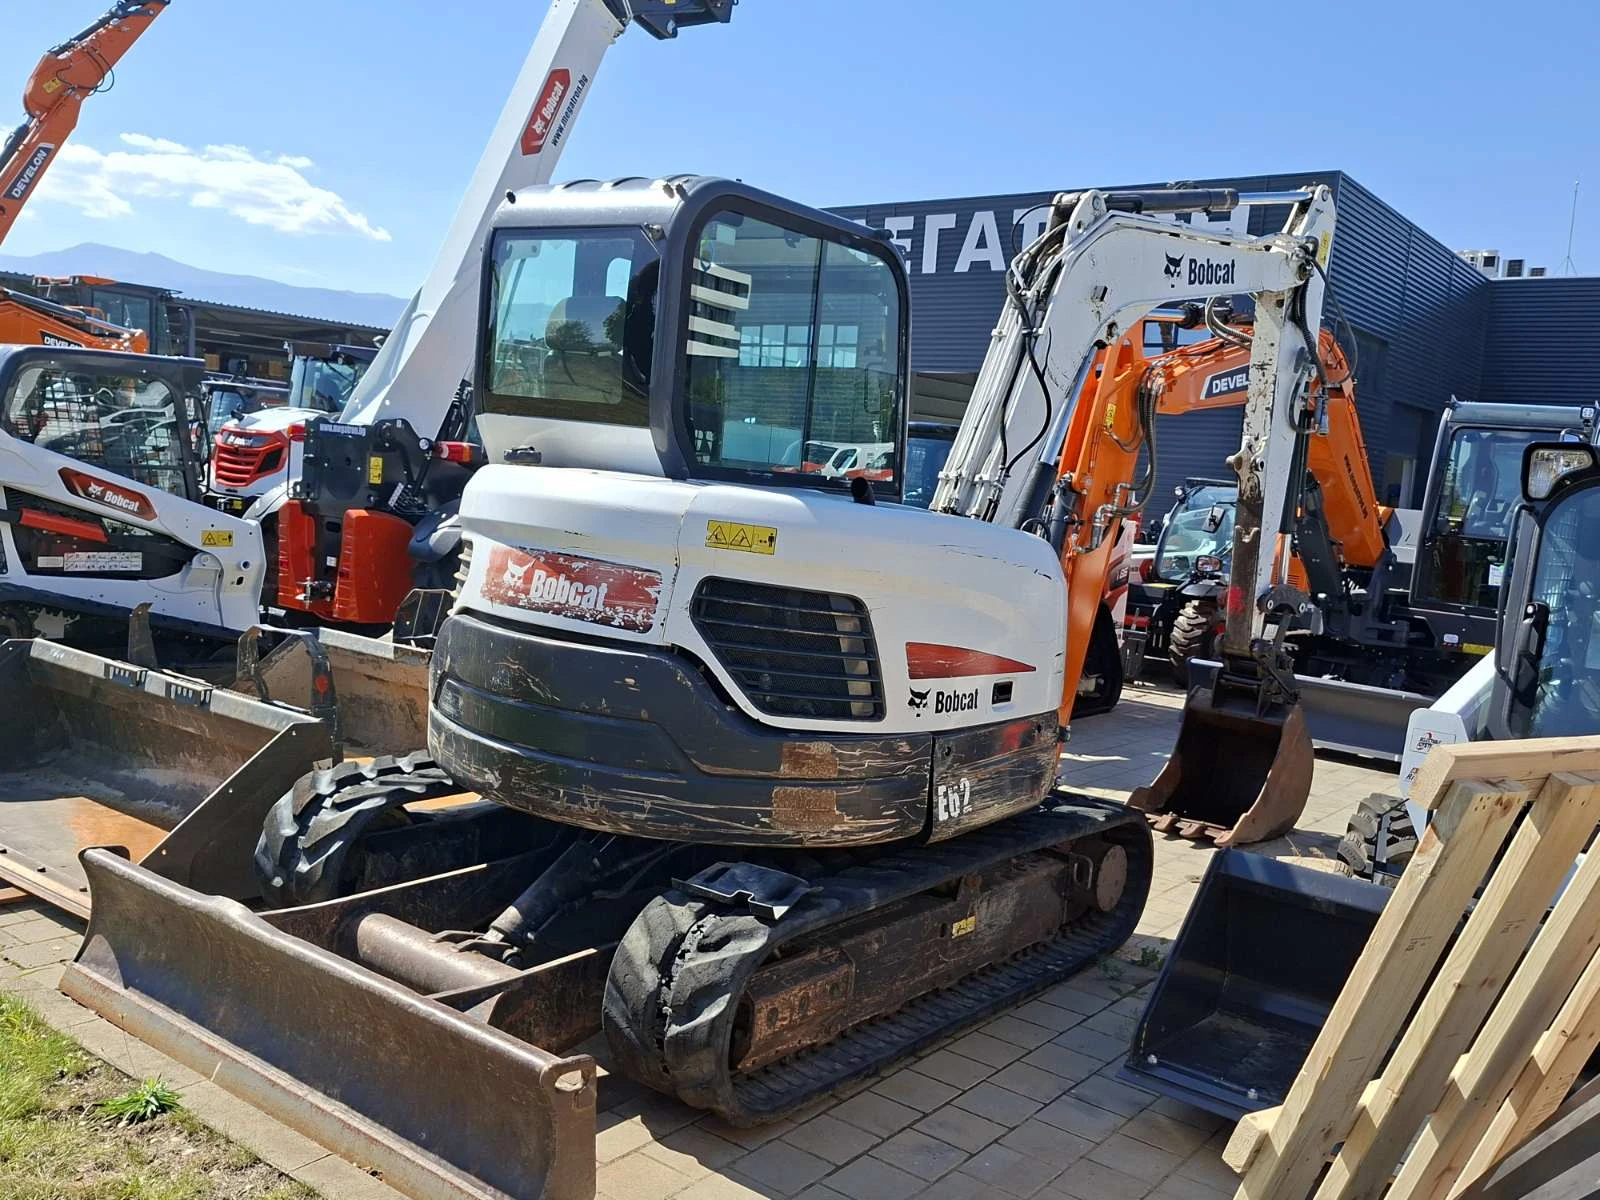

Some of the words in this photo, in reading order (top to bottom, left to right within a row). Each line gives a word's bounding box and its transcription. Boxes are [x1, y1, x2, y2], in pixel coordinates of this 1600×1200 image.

[541, 81, 564, 120] Bobcat
[551, 73, 588, 147] www.megatron.bg
[11, 149, 47, 198] DEVELON
[1188, 258, 1235, 285] Bobcat
[1212, 373, 1250, 394] DEVEL
[103, 490, 139, 513] Bobcat
[529, 569, 608, 609] Bobcat
[935, 688, 978, 714] Bobcat
[937, 777, 973, 822] E62
